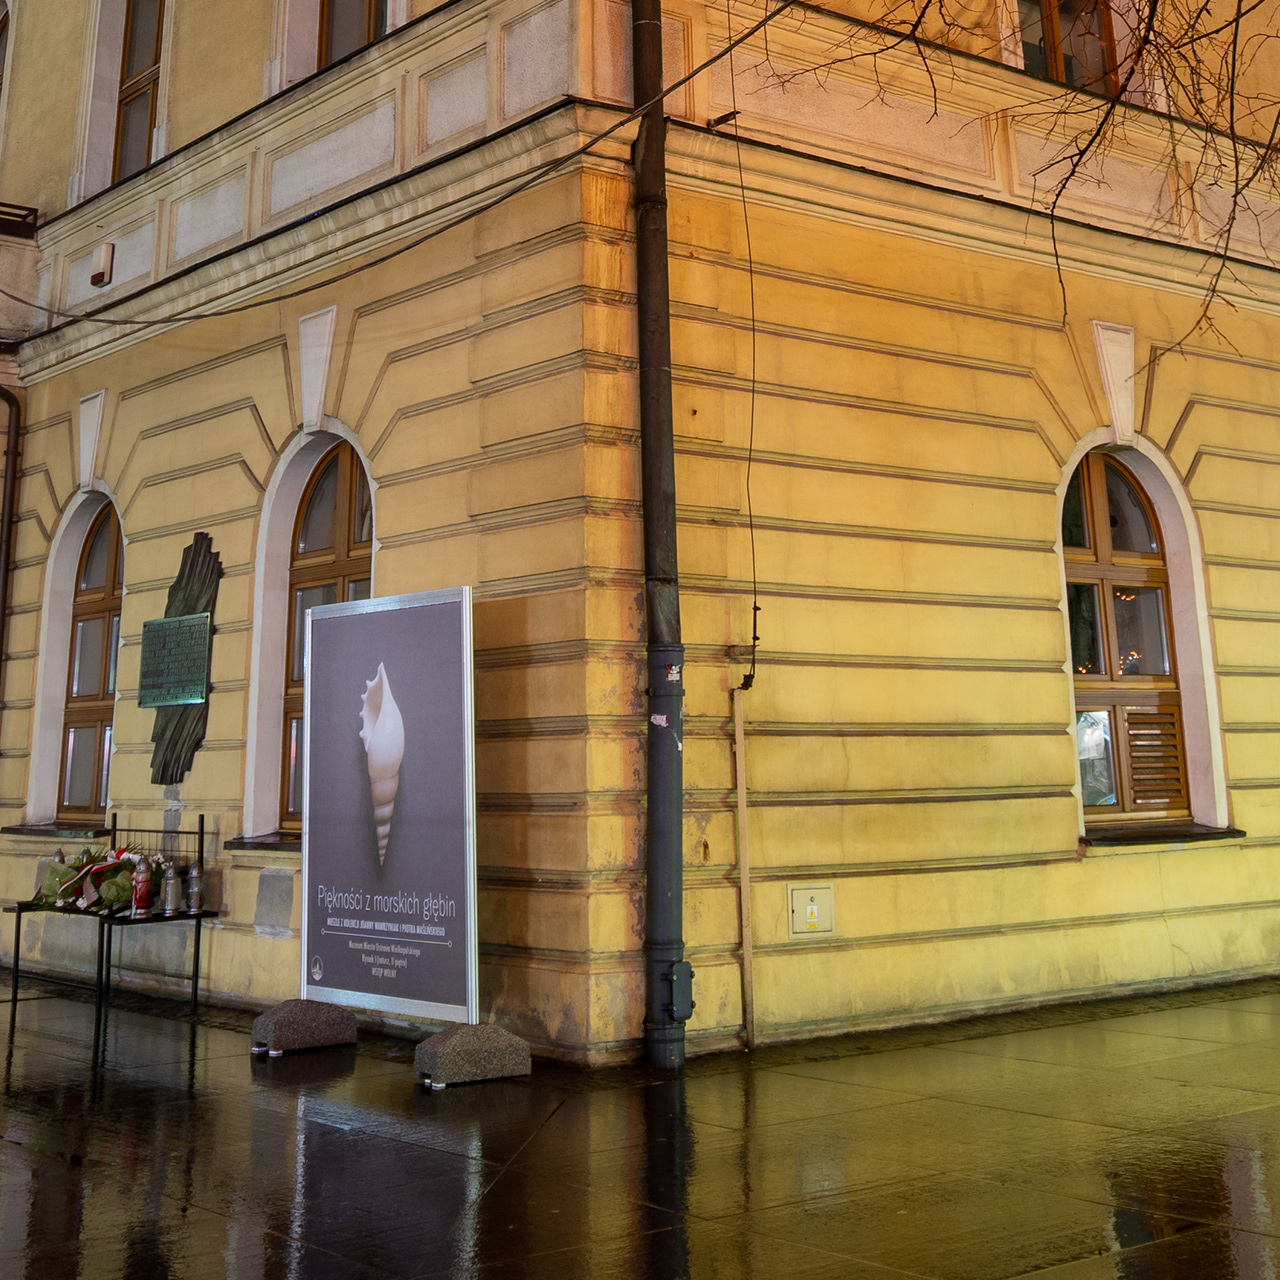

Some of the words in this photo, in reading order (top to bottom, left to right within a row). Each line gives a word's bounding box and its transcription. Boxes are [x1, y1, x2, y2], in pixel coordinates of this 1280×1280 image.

[317, 885, 363, 913] Piękności
[365, 894, 371, 911] z
[373, 890, 420, 915] morskich
[422, 893, 456, 921] głębin
